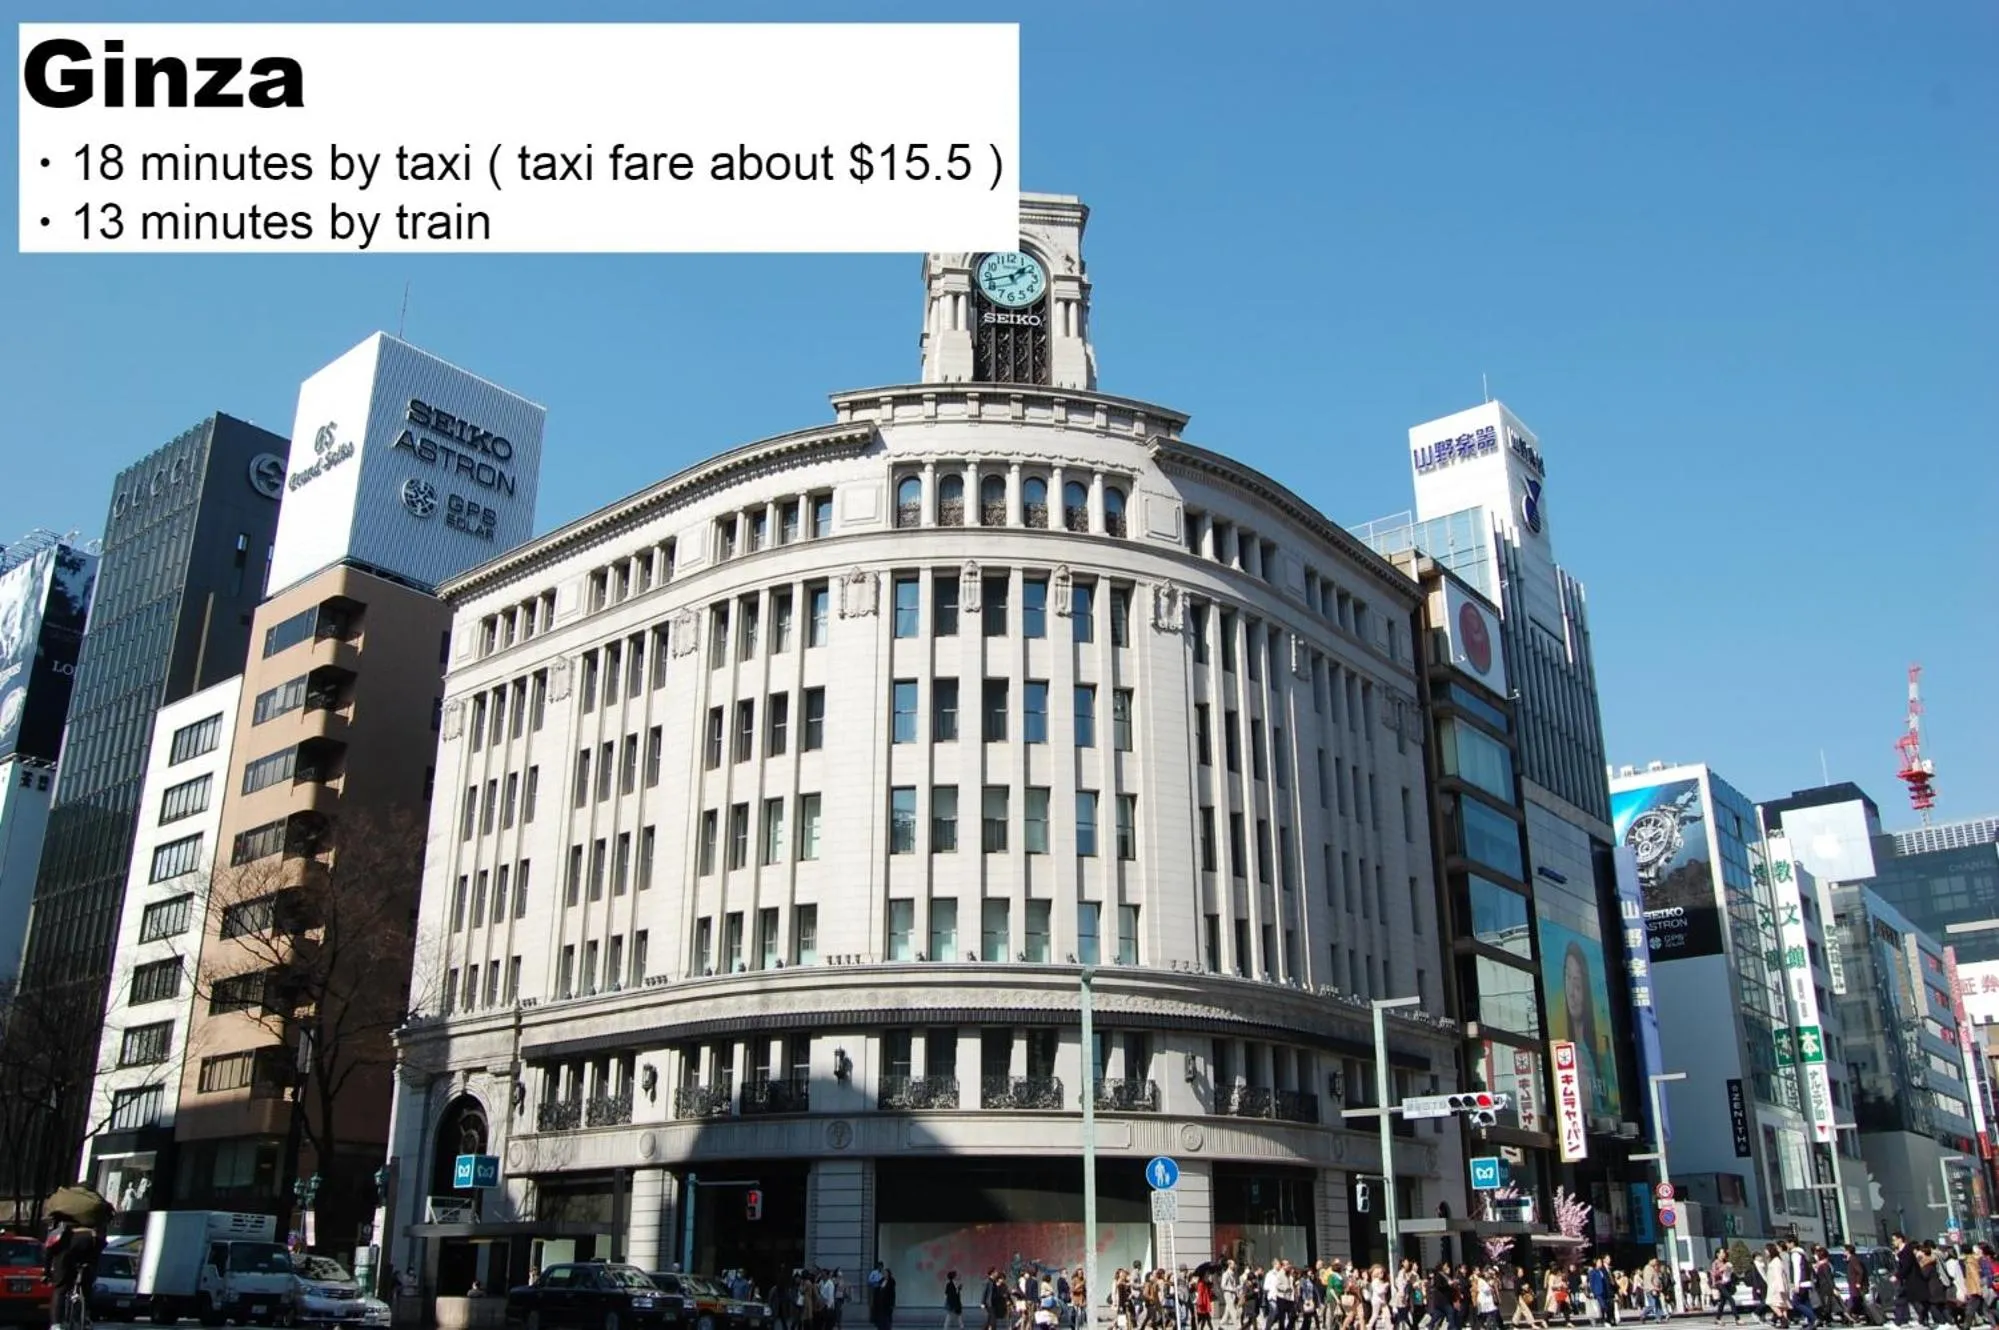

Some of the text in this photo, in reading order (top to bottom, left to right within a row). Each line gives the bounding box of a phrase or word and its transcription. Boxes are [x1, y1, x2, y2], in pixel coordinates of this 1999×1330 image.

[984, 313, 1041, 326] SEIKO
[407, 399, 513, 460] SEIKO
[1413, 425, 1497, 471] 山野楽器
[392, 430, 516, 497] ASTRON
[1647, 918, 1688, 930] STRON
[1731, 1092, 1747, 1143] ZENITH
